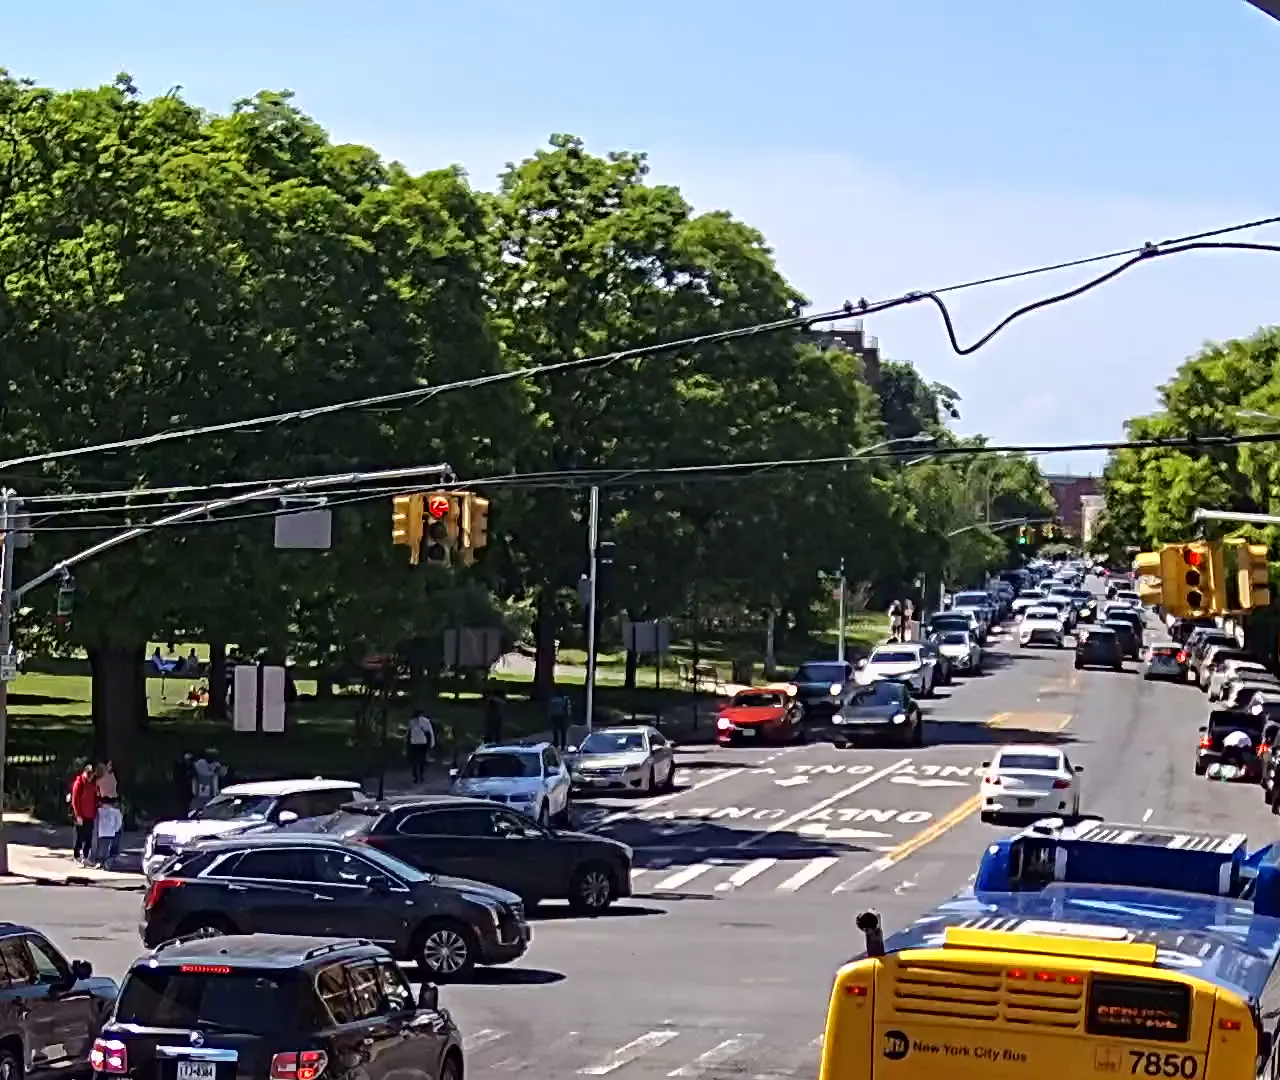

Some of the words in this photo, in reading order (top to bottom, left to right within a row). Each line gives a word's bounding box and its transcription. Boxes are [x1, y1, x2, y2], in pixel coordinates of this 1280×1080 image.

[805, 807, 933, 823] ONLY
[912, 1040, 940, 1053] New
[944, 1043, 970, 1057] York
[974, 1046, 1001, 1062] City
[1003, 1047, 1028, 1062] Bus
[1128, 1049, 1199, 1080] 7850
